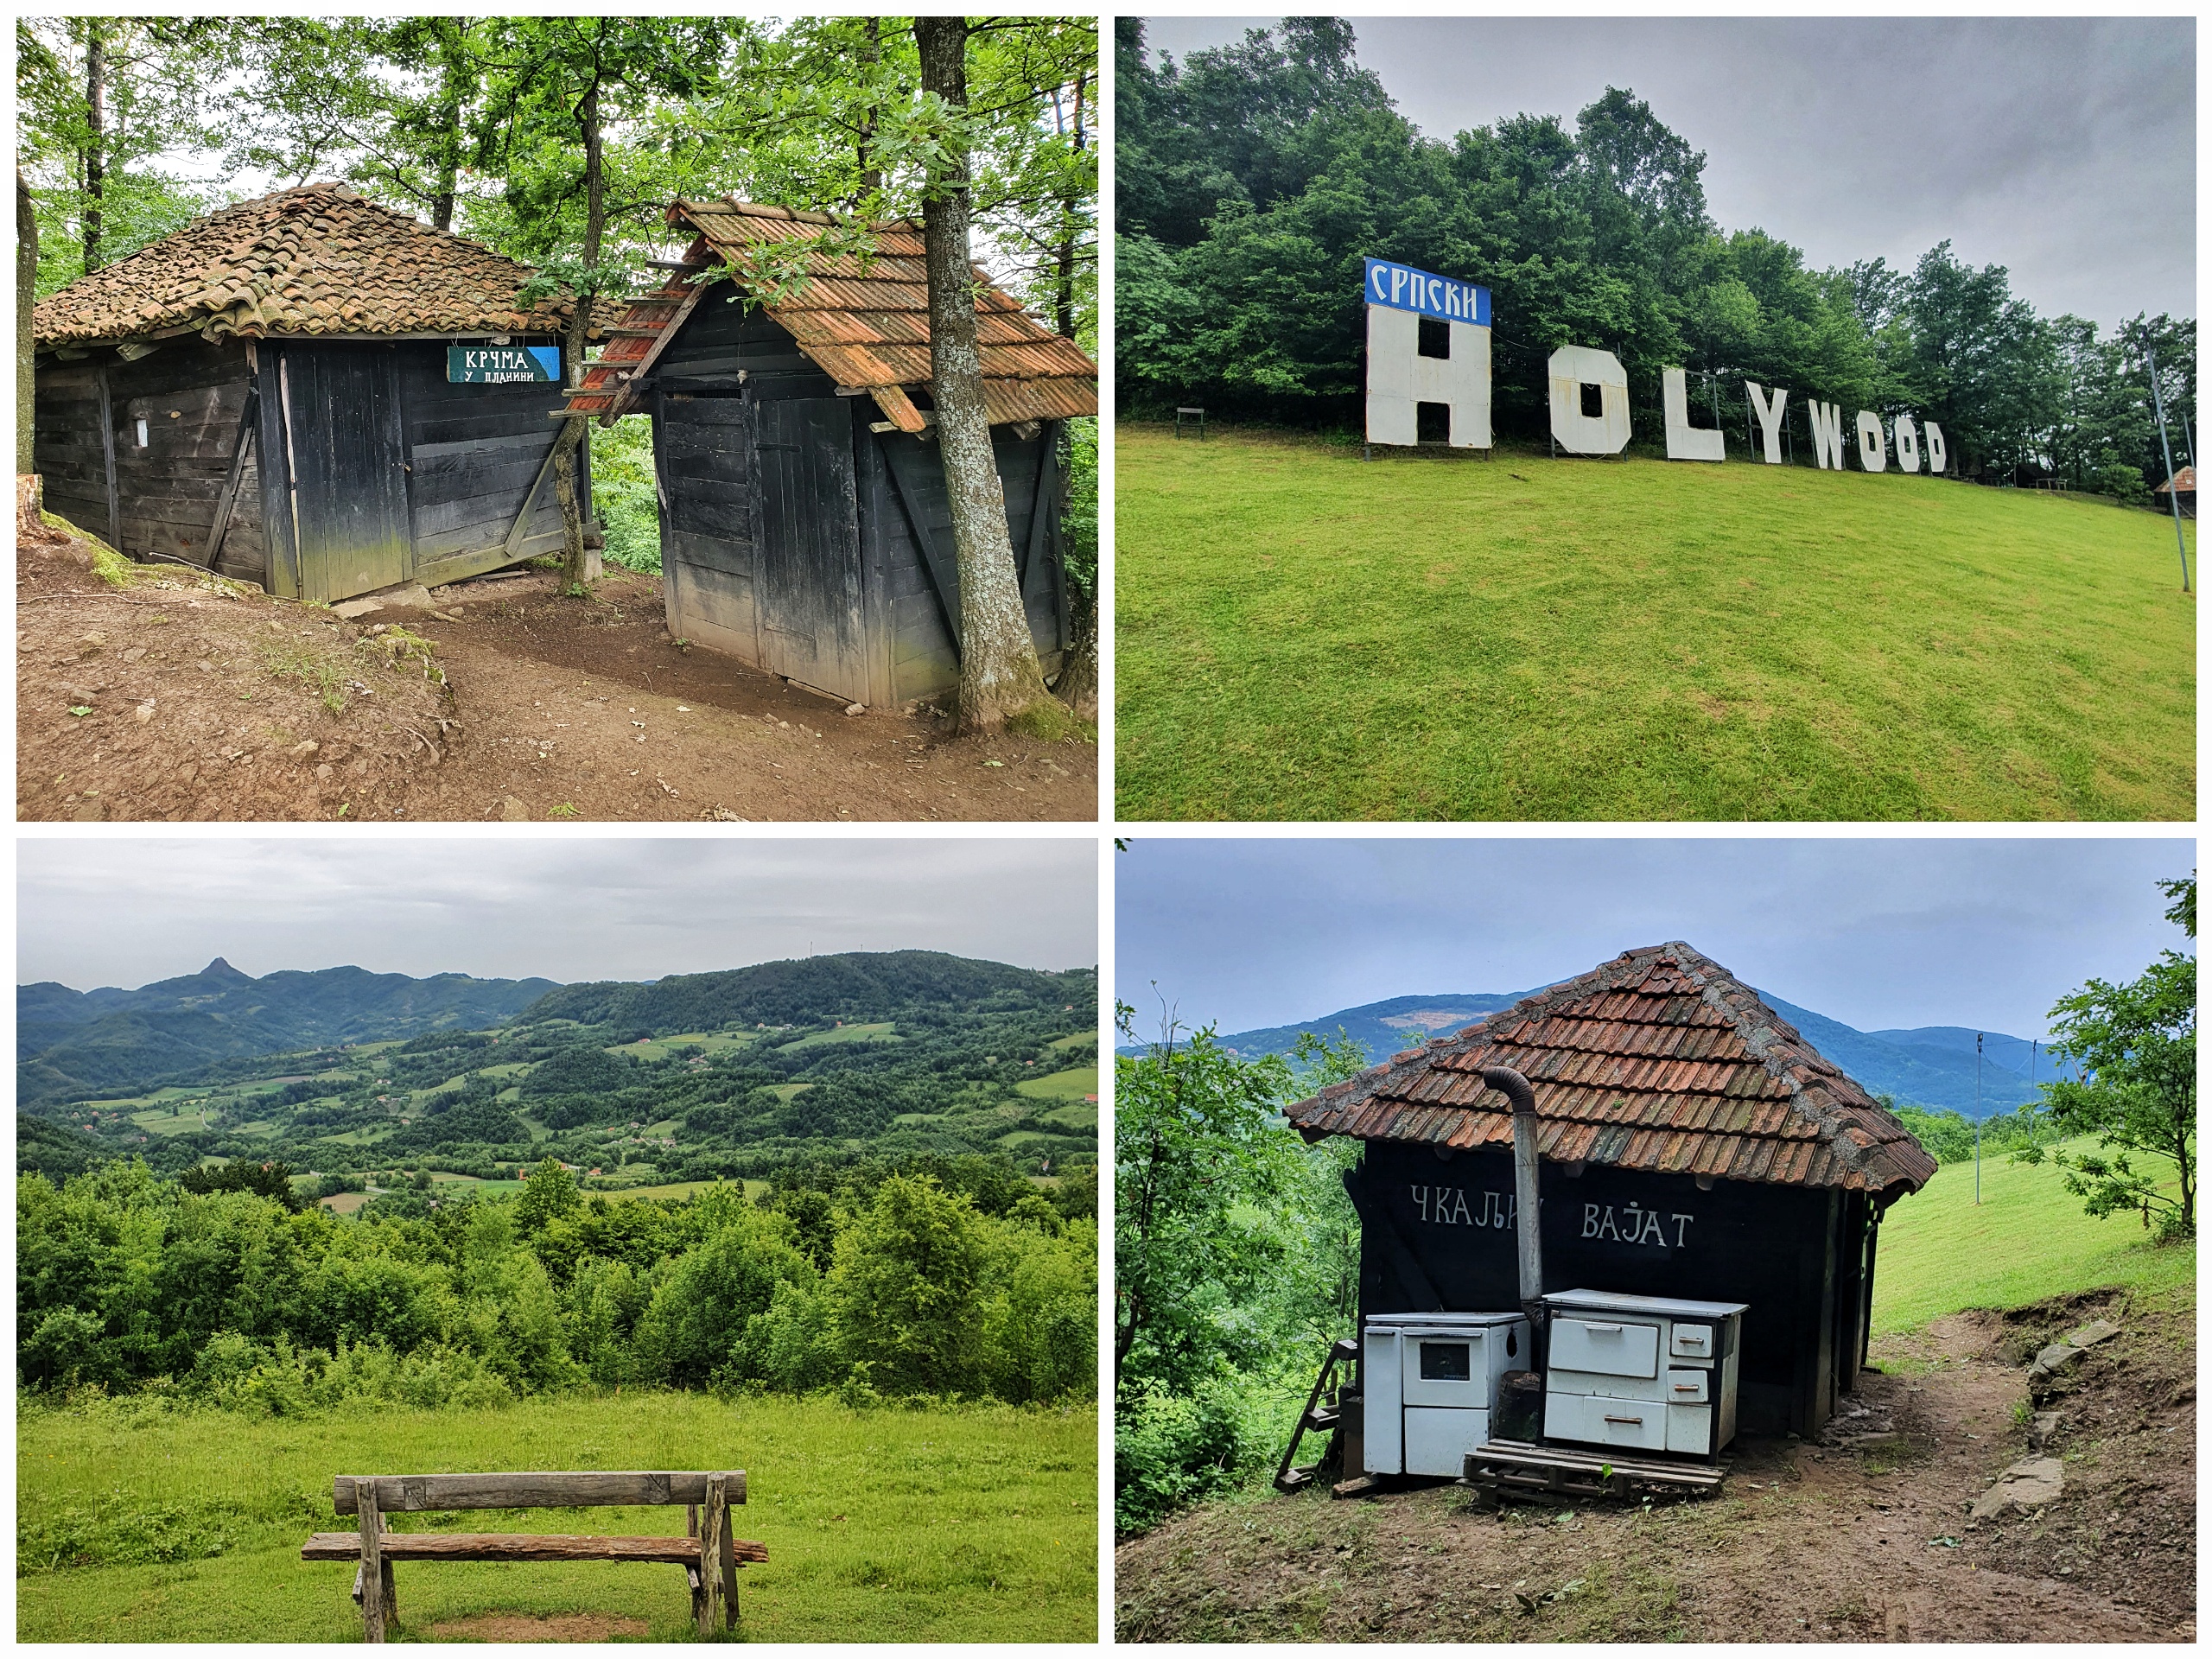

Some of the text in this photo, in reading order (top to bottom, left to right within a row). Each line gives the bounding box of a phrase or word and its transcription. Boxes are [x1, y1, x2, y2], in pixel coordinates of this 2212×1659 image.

[1370, 264, 1478, 320] СРПСКИ
[464, 371, 534, 384] У ПЛАНИНИ
[465, 351, 528, 369] КРЧМА
[1365, 302, 1946, 473] HOLYWOOD
[1410, 1185, 1694, 1247] ЧКАЉИ ВАЈАТ
